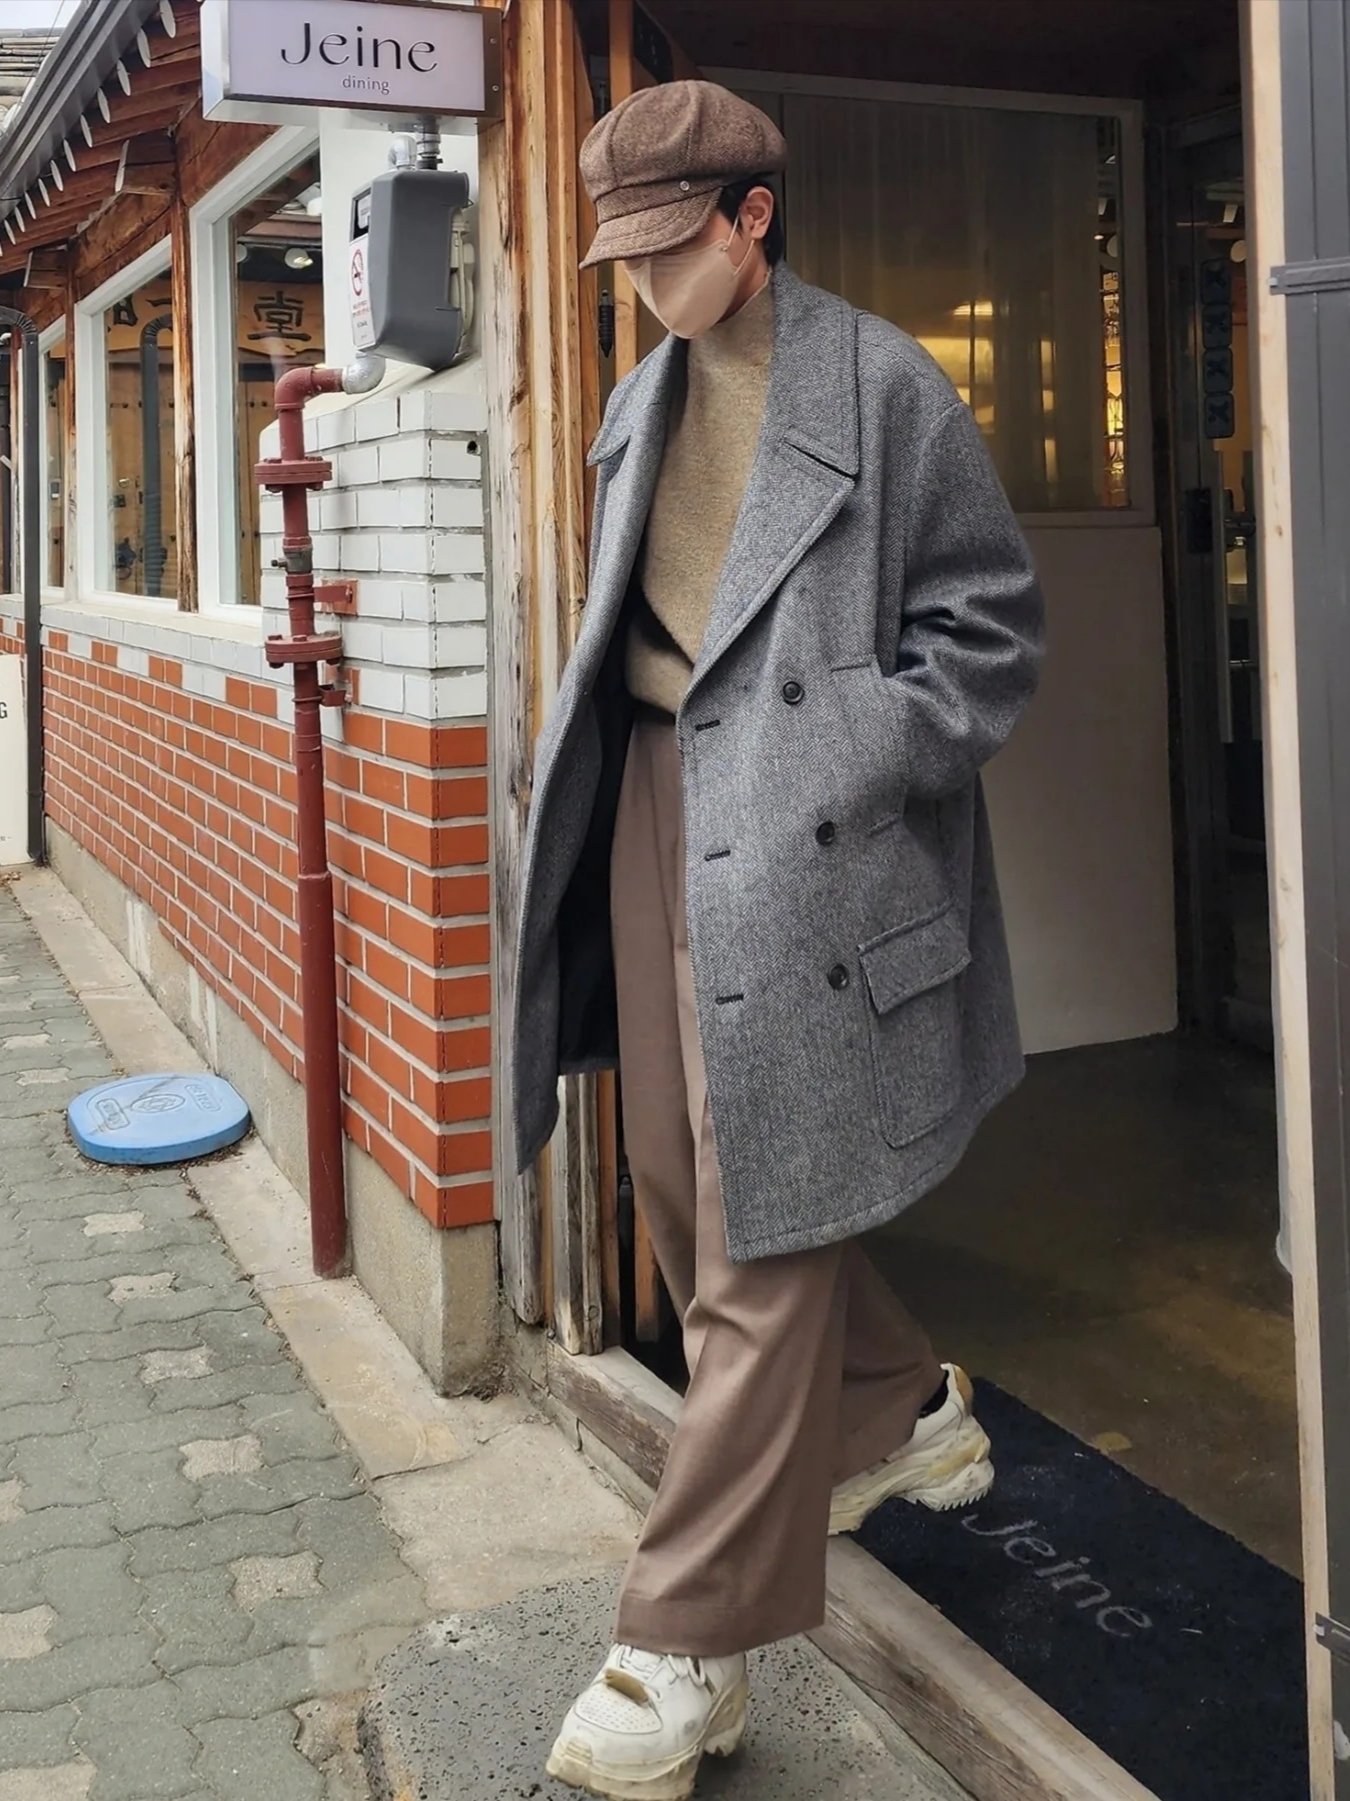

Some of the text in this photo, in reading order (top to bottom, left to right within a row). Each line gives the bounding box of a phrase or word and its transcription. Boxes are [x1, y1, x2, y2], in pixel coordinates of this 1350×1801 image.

[281, 22, 437, 72] Jeine
[342, 75, 390, 95] dining
[961, 1513, 1153, 1637] Jeine
